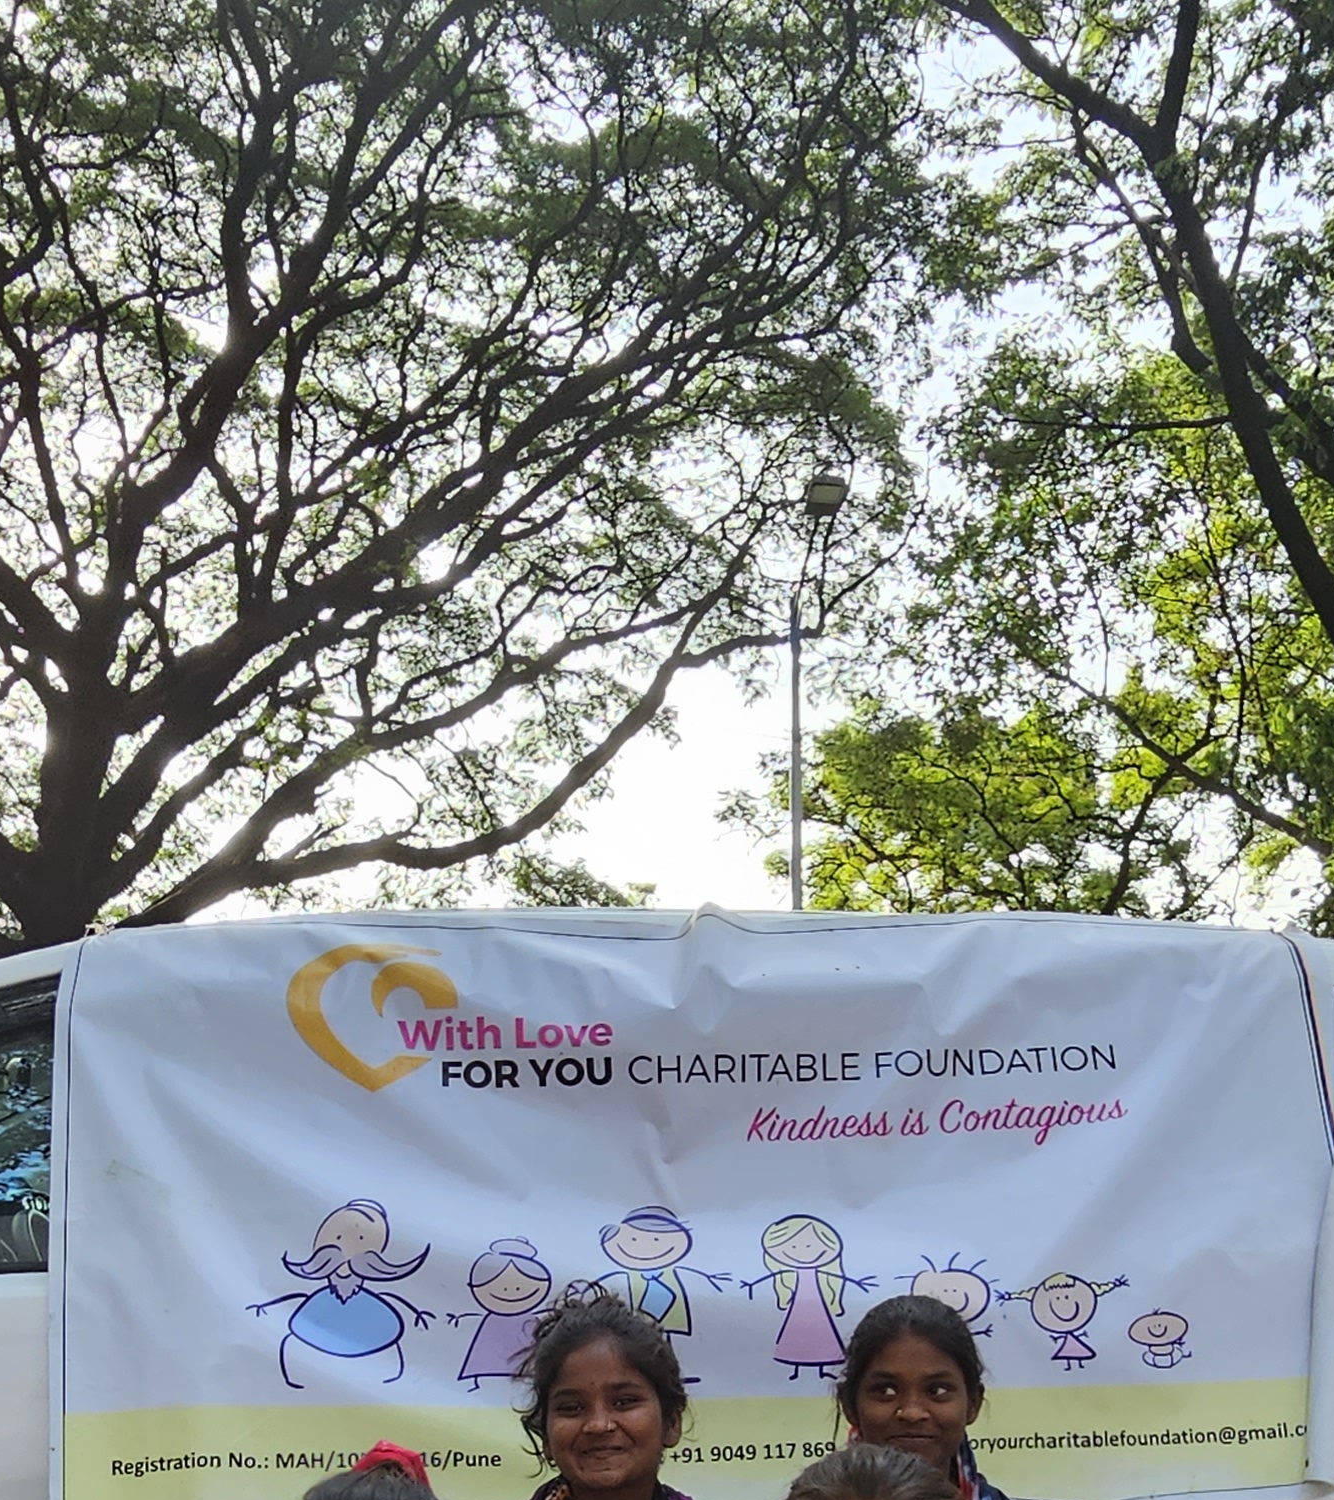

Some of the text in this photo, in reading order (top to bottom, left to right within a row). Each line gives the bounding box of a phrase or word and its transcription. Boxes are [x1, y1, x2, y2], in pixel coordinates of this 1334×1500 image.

[399, 1016, 613, 1052] With Love
[441, 1043, 1117, 1089] FOR YOU CHARITABLE FOUNDATION
[747, 1097, 1128, 1146] Kindness is Contagious
[669, 1441, 836, 1464] +91 9049 117 869
[968, 1422, 1308, 1454] oryourcharitablefoundation@gmail.c
[111, 1451, 222, 1478] Registration
[228, 1451, 269, 1470] No.:
